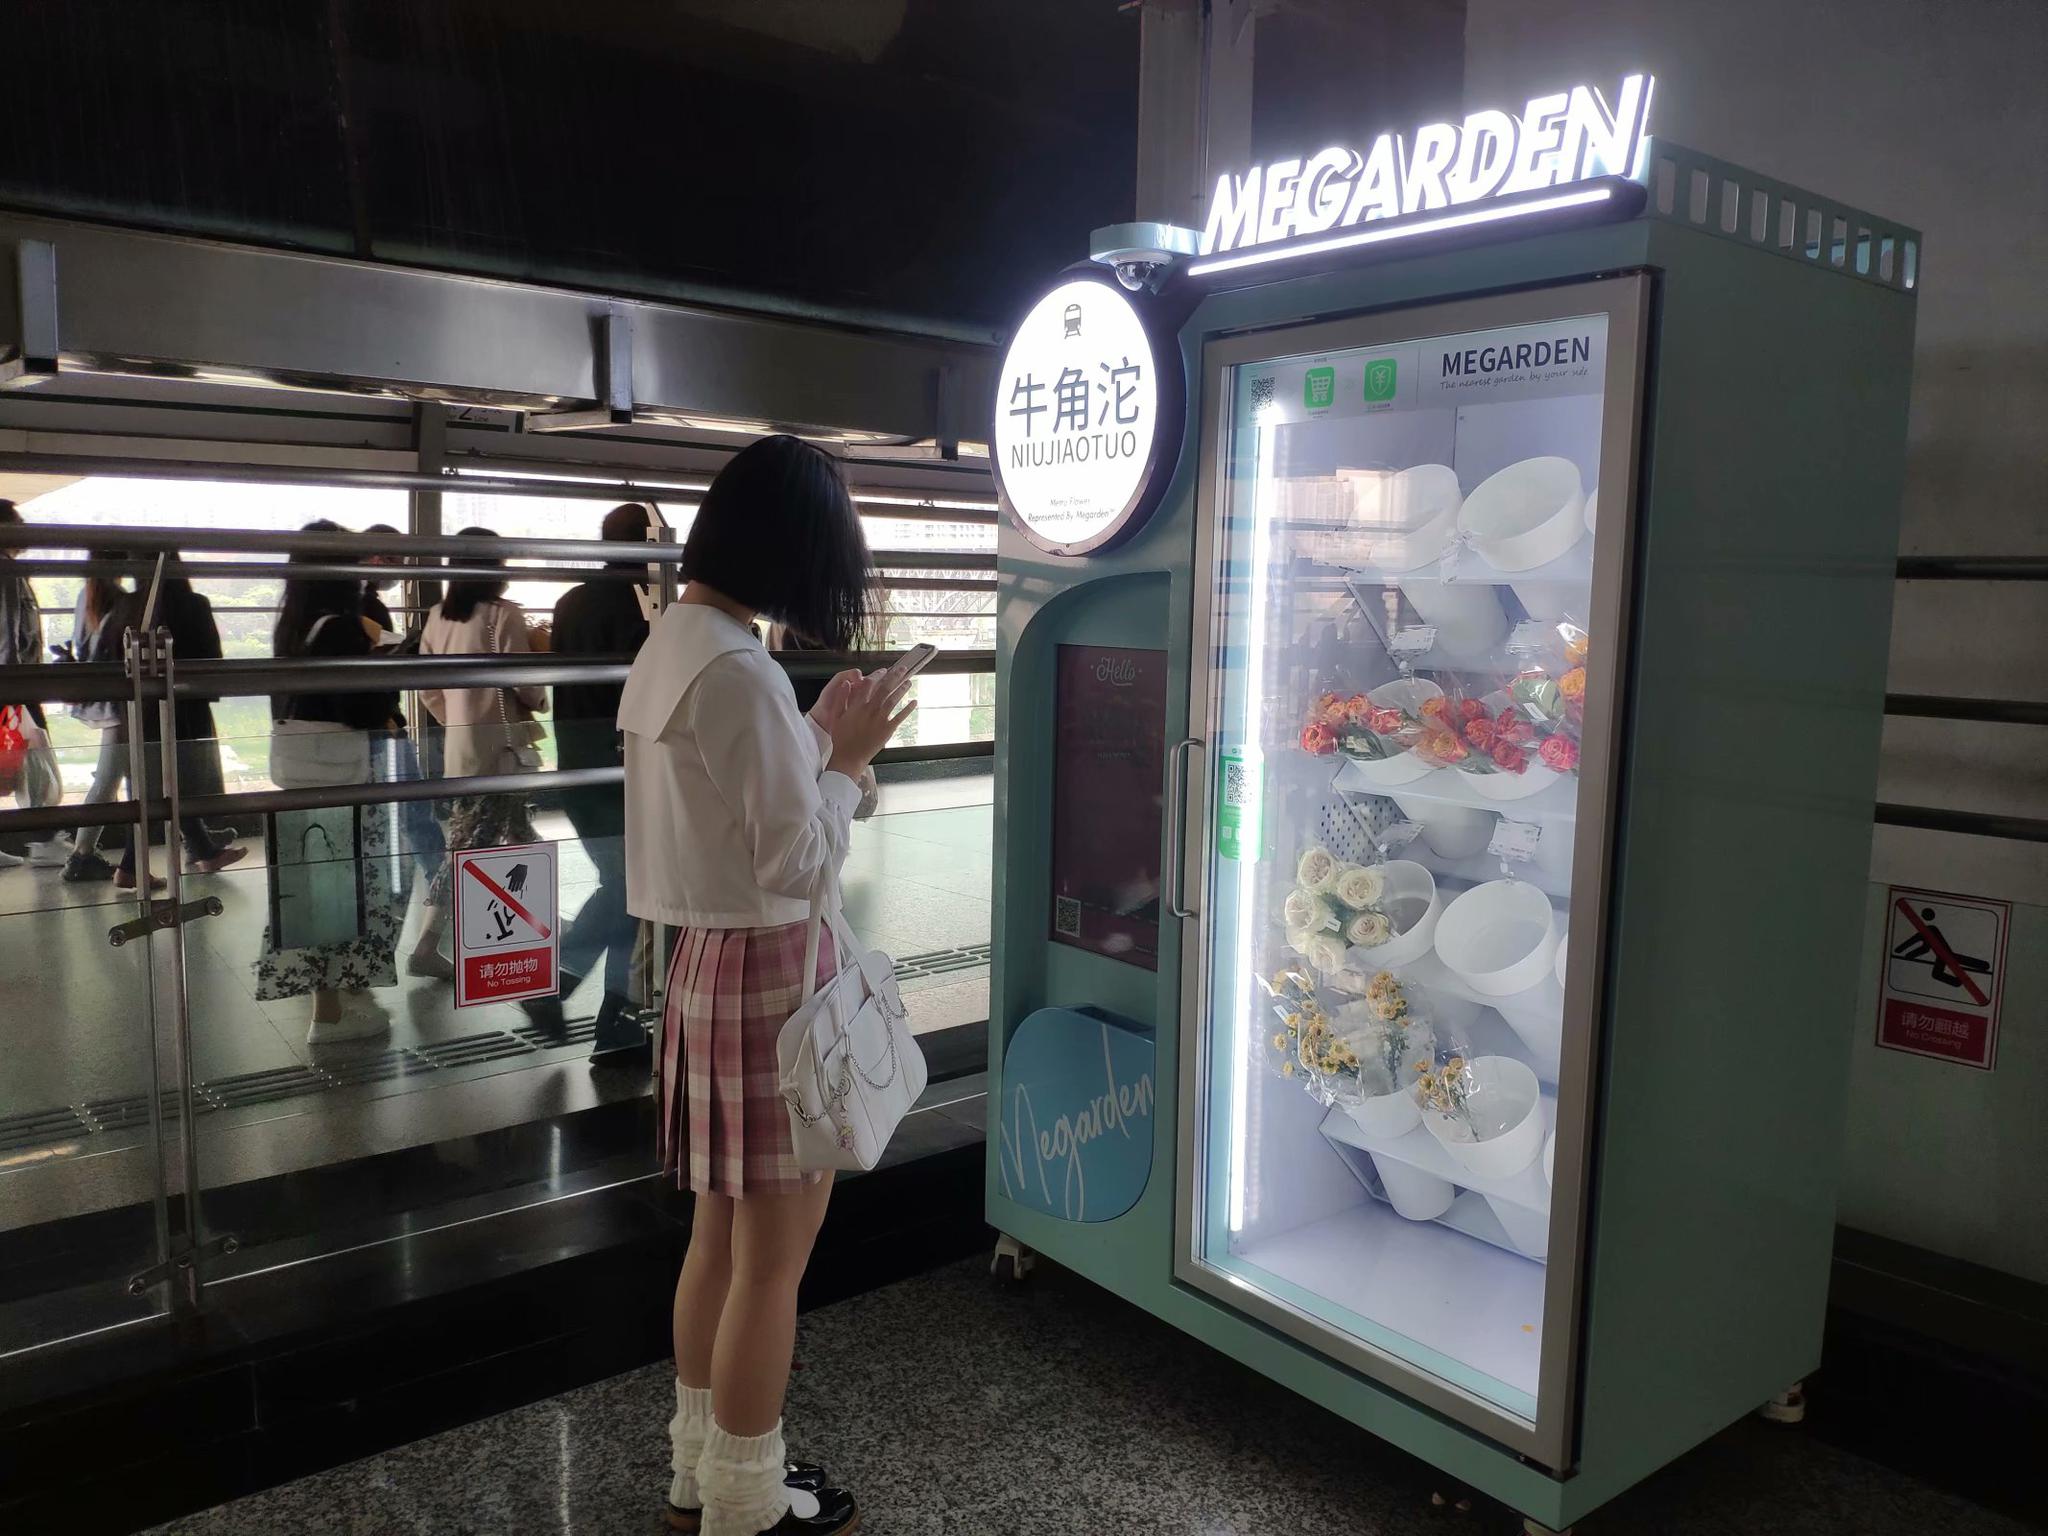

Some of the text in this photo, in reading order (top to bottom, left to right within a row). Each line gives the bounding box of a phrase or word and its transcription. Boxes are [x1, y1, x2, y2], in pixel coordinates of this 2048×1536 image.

[1199, 74, 1655, 255] MEGARDEN
[1441, 336, 1590, 378] MEGARDEN
[1440, 382, 1456, 391] The
[1458, 377, 1492, 389] nearest
[1493, 374, 1526, 387] garden
[1529, 370, 1541, 383] by
[1544, 370, 1568, 382] your
[1008, 356, 1141, 437] 牛角沱
[1011, 430, 1137, 469] NIUJIAOTUO
[1028, 511, 1065, 523] Represented
[1065, 511, 1074, 521] By
[1096, 656, 1136, 686] Hello
[479, 957, 538, 979] 请勿抛物
[487, 976, 531, 988] No Tossing
[1901, 1011, 1969, 1040] 请勿翻越
